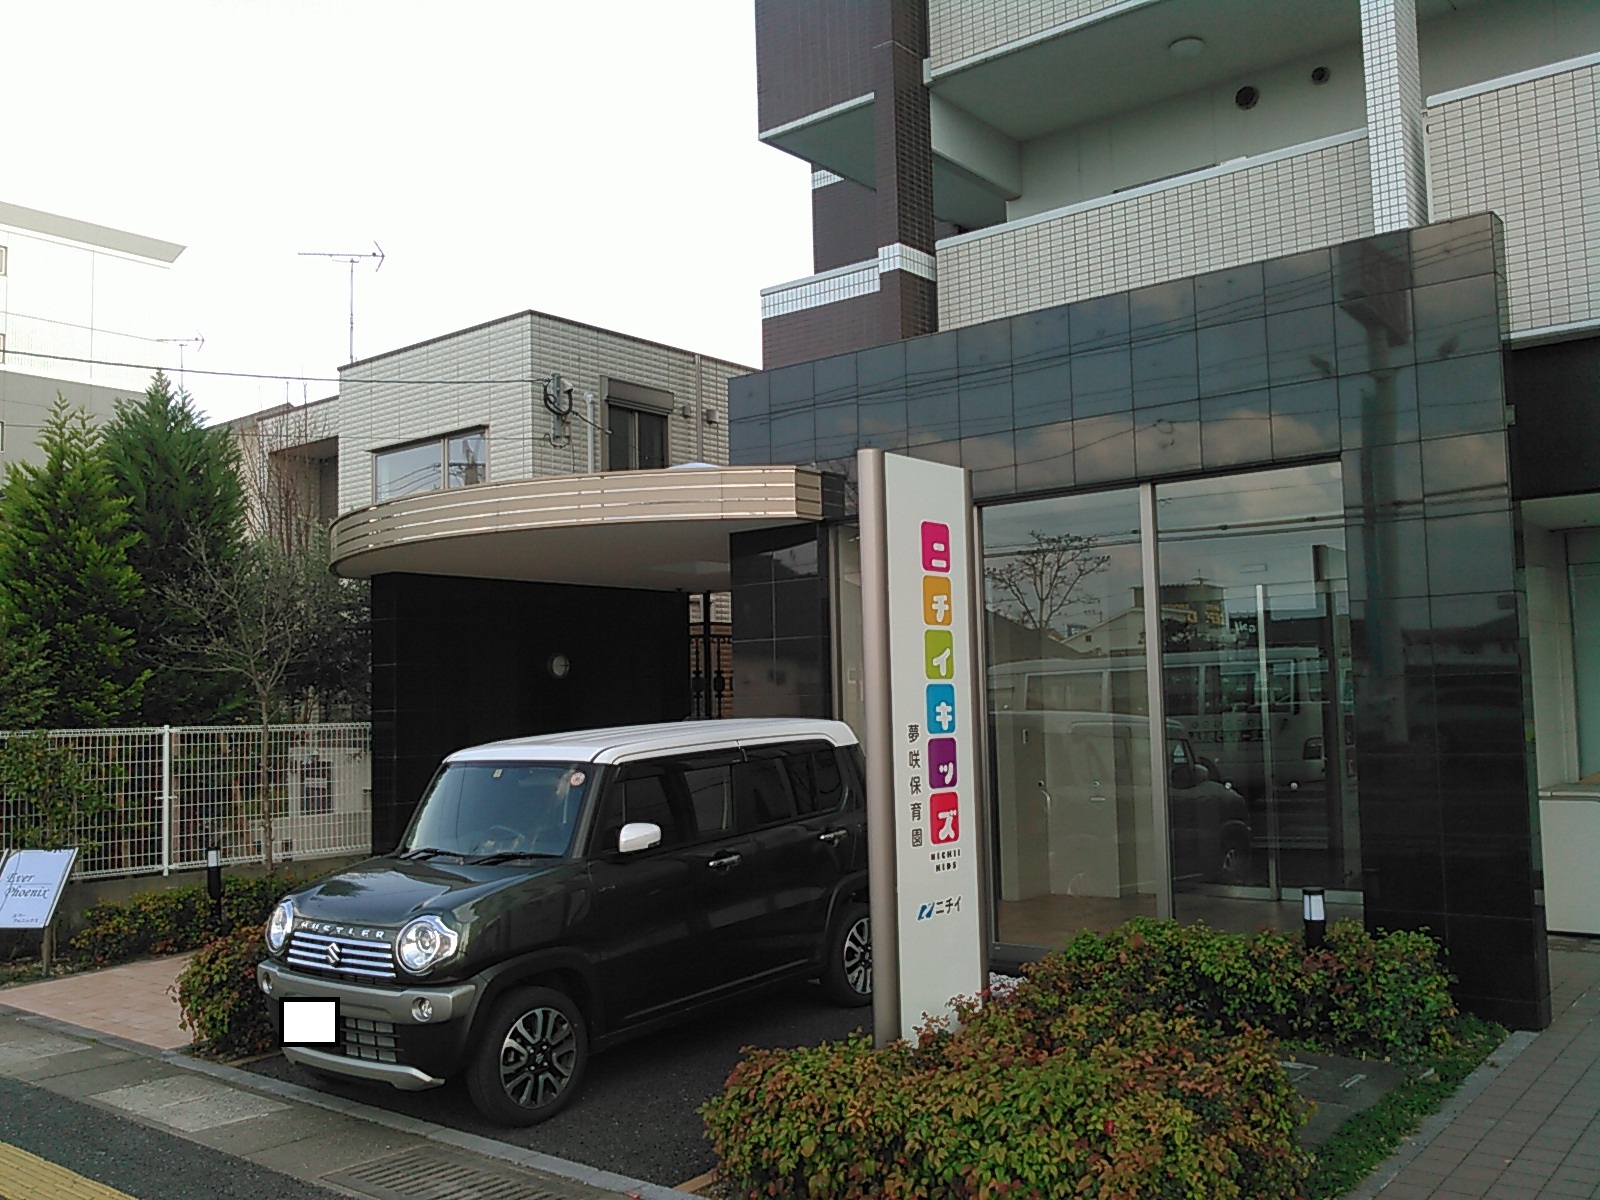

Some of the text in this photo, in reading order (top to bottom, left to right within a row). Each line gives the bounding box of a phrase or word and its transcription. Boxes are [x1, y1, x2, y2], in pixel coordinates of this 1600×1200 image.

[929, 541, 958, 841] ニチイキッズ
[907, 724, 923, 847] 夢咲保育園
[931, 849, 961, 861] NICHII
[936, 861, 957, 873] KIDS
[6, 873, 35, 883] Ever
[5, 886, 49, 899] Phoenix
[936, 896, 962, 914] ニチイ
[301, 921, 385, 939] HUSTLER
